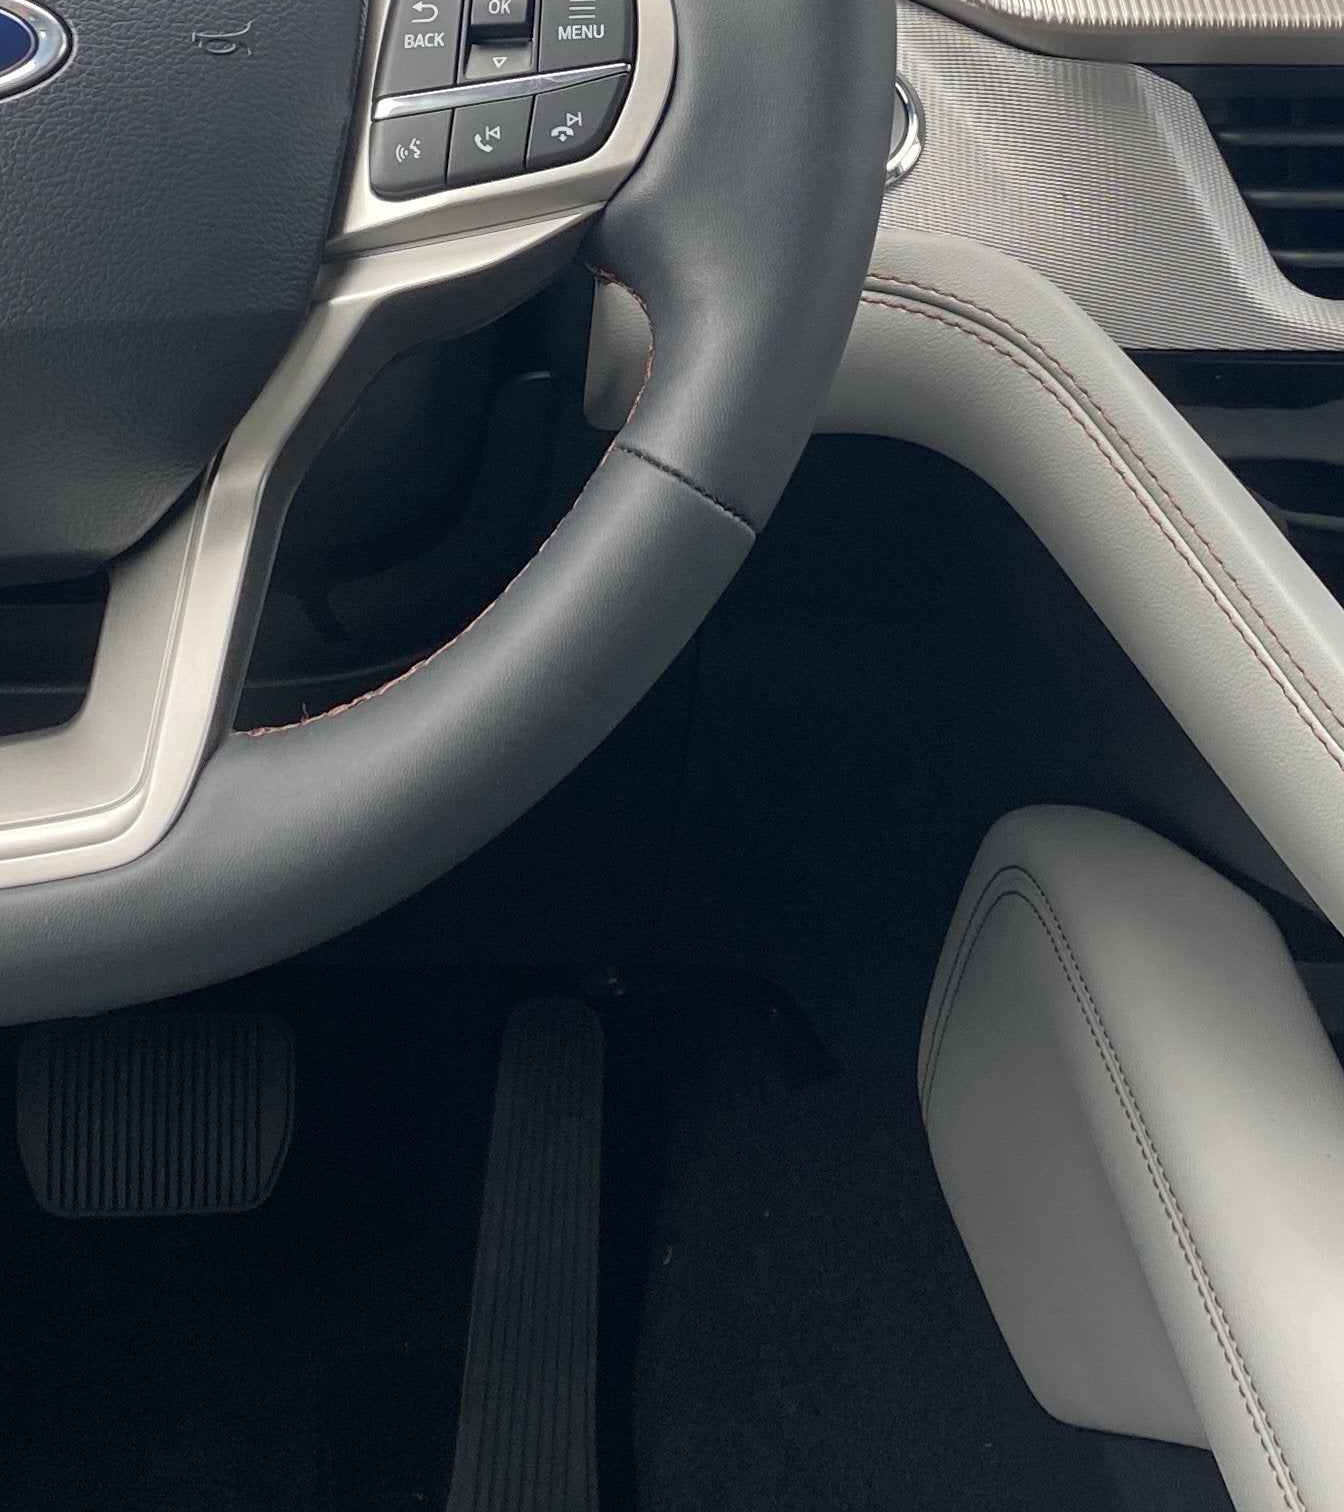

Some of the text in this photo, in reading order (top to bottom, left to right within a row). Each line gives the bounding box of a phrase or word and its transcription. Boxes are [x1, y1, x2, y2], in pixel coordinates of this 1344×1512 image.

[488, 0, 511, 14] OK
[558, 24, 605, 40] MENU
[404, 32, 445, 49] BACK
